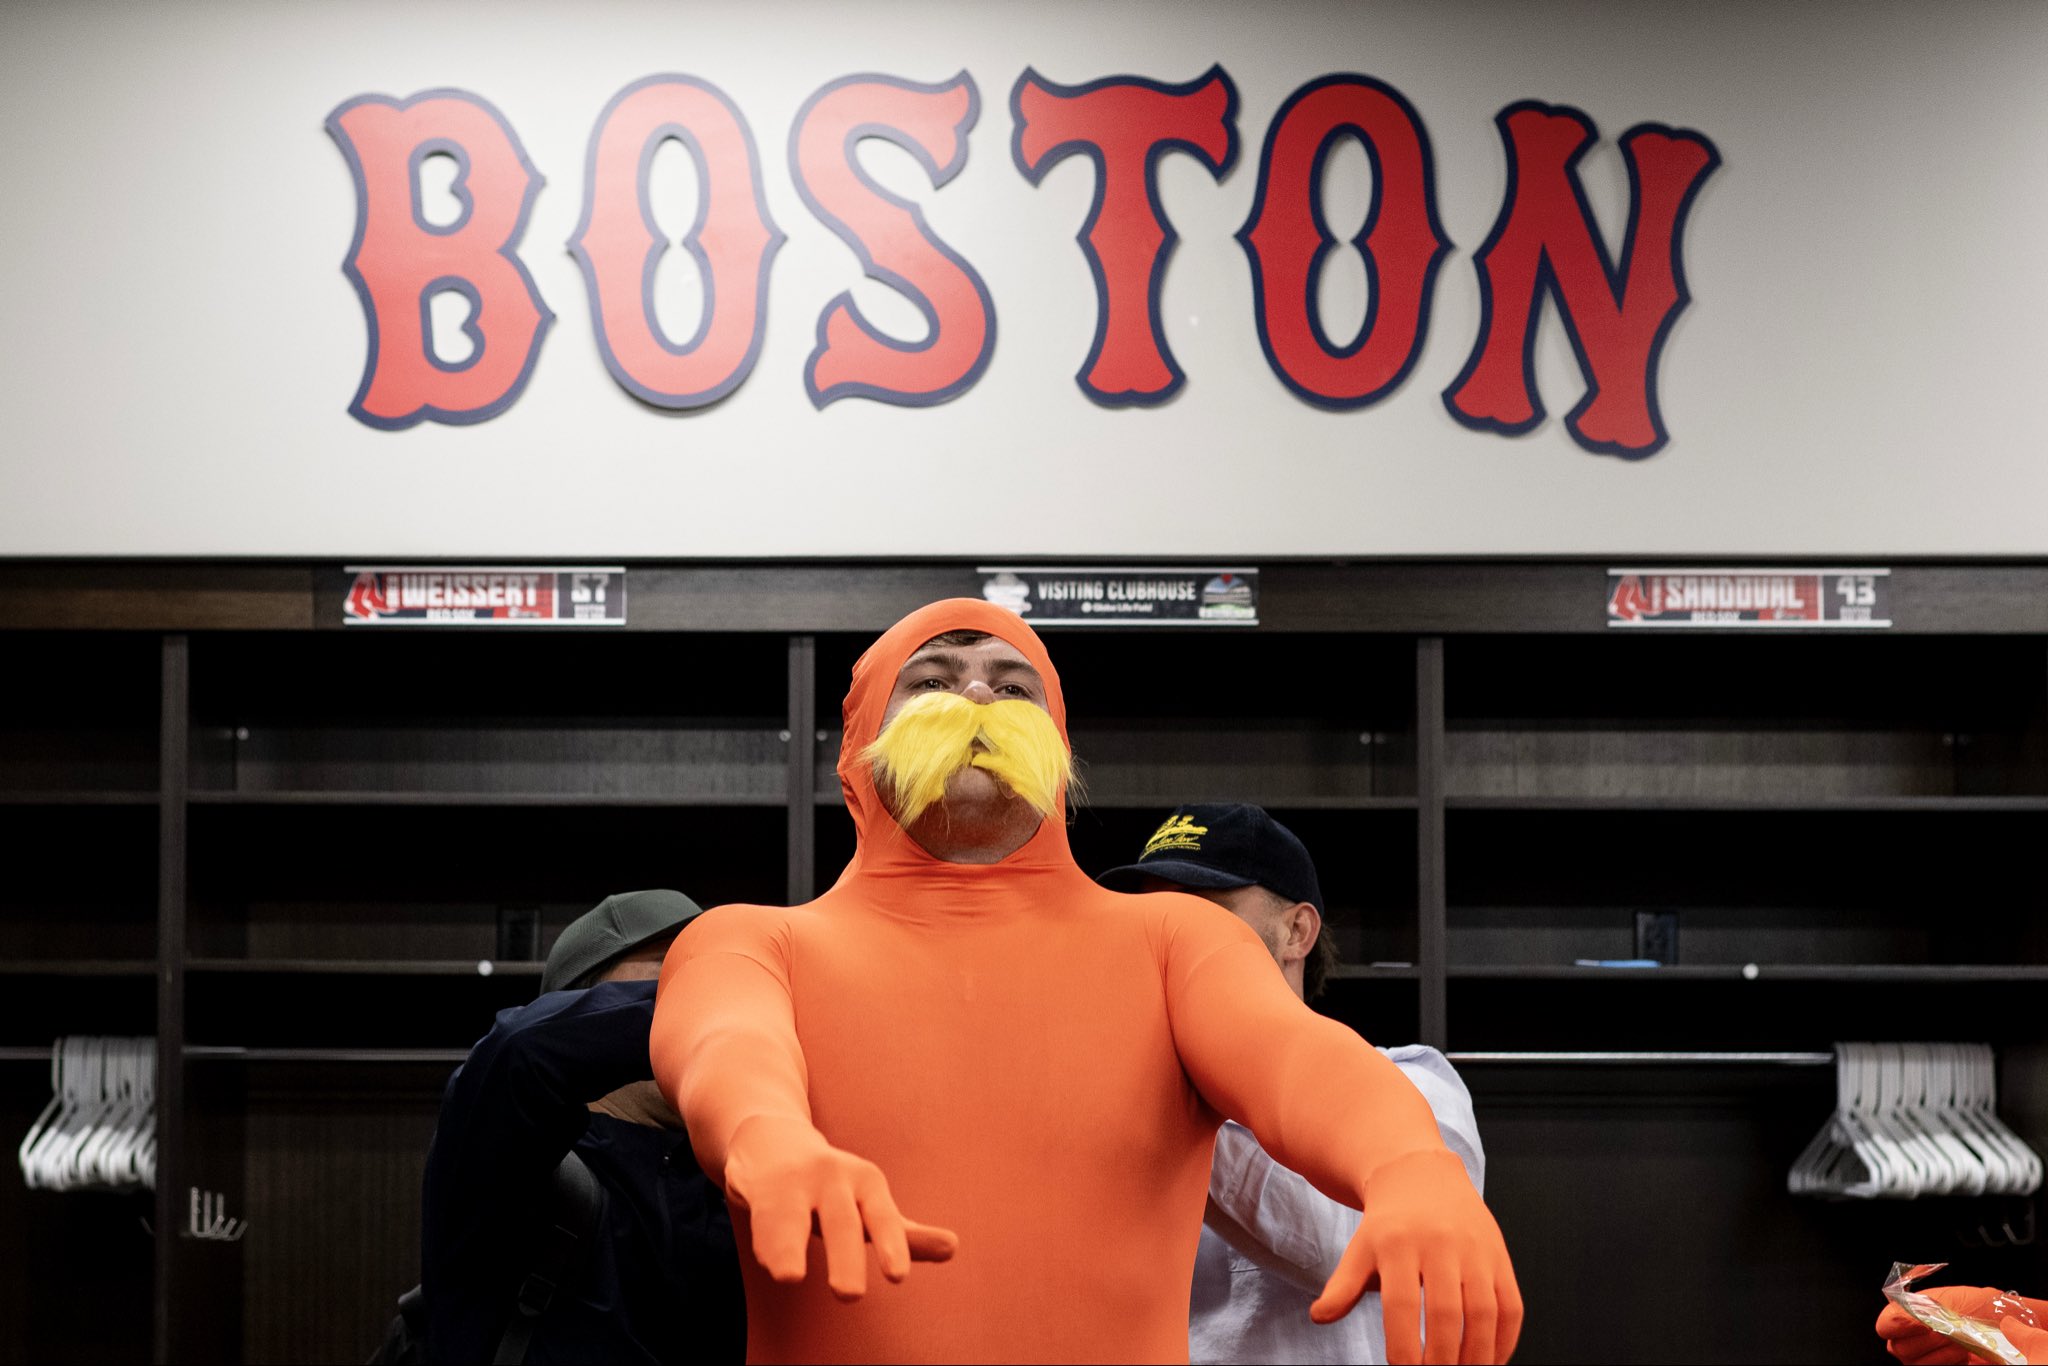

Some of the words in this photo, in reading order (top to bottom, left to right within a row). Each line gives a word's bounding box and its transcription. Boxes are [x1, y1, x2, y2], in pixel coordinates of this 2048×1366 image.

[325, 64, 1723, 460] BOSTON
[401, 574, 540, 607] WEISSERT
[571, 573, 609, 604] 57
[1038, 581, 1104, 600] VISITING
[1107, 581, 1196, 600] CLUBHOUSE
[1665, 576, 1804, 609] SANDOVAL
[1836, 576, 1876, 606] 43
